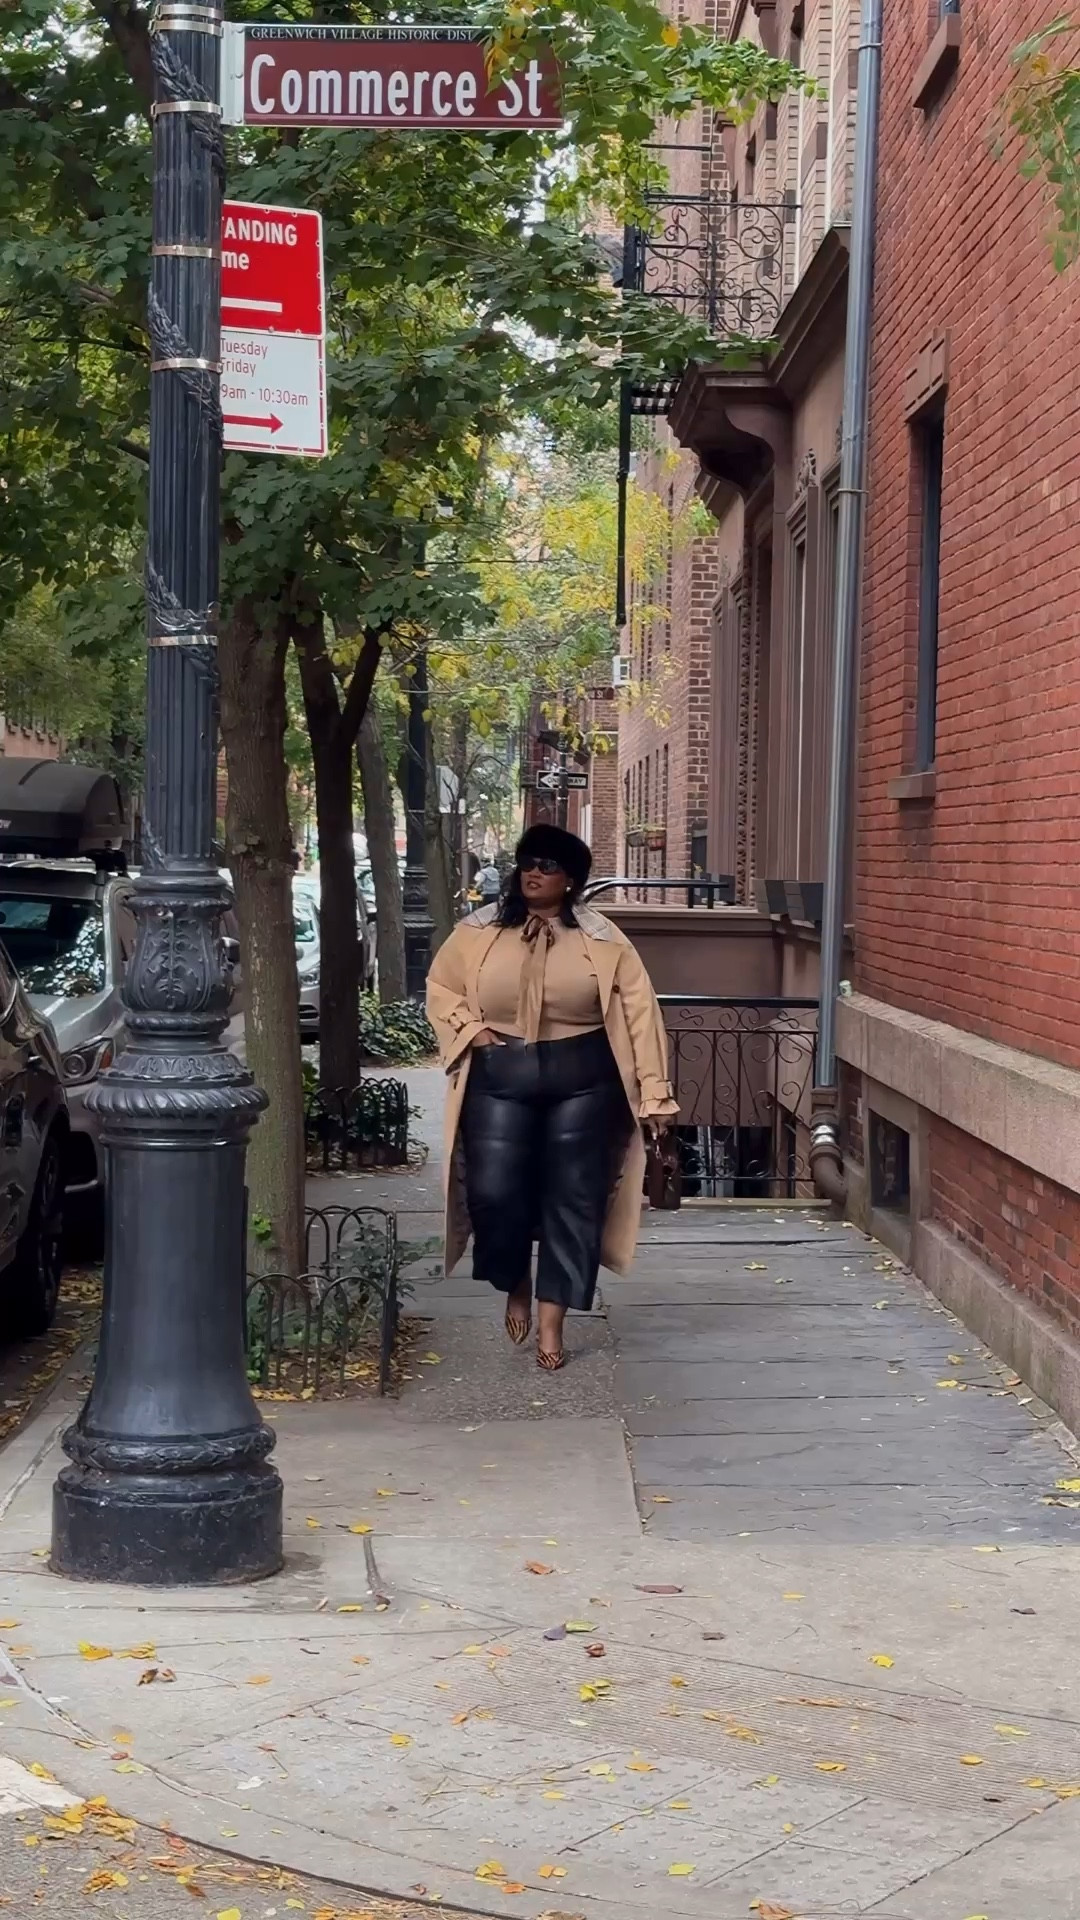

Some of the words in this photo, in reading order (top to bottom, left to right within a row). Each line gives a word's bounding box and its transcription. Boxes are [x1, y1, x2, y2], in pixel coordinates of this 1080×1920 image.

[251, 27, 326, 40] GREENWICH
[332, 28, 383, 40] VILLAGE
[388, 29, 443, 41] HISTORIC
[250, 53, 477, 116] Commerce
[222, 215, 298, 247] ANDING
[221, 250, 250, 270] me
[220, 337, 268, 359] Tuesday
[221, 383, 247, 400] 9am
[259, 387, 309, 406] 10:30am
